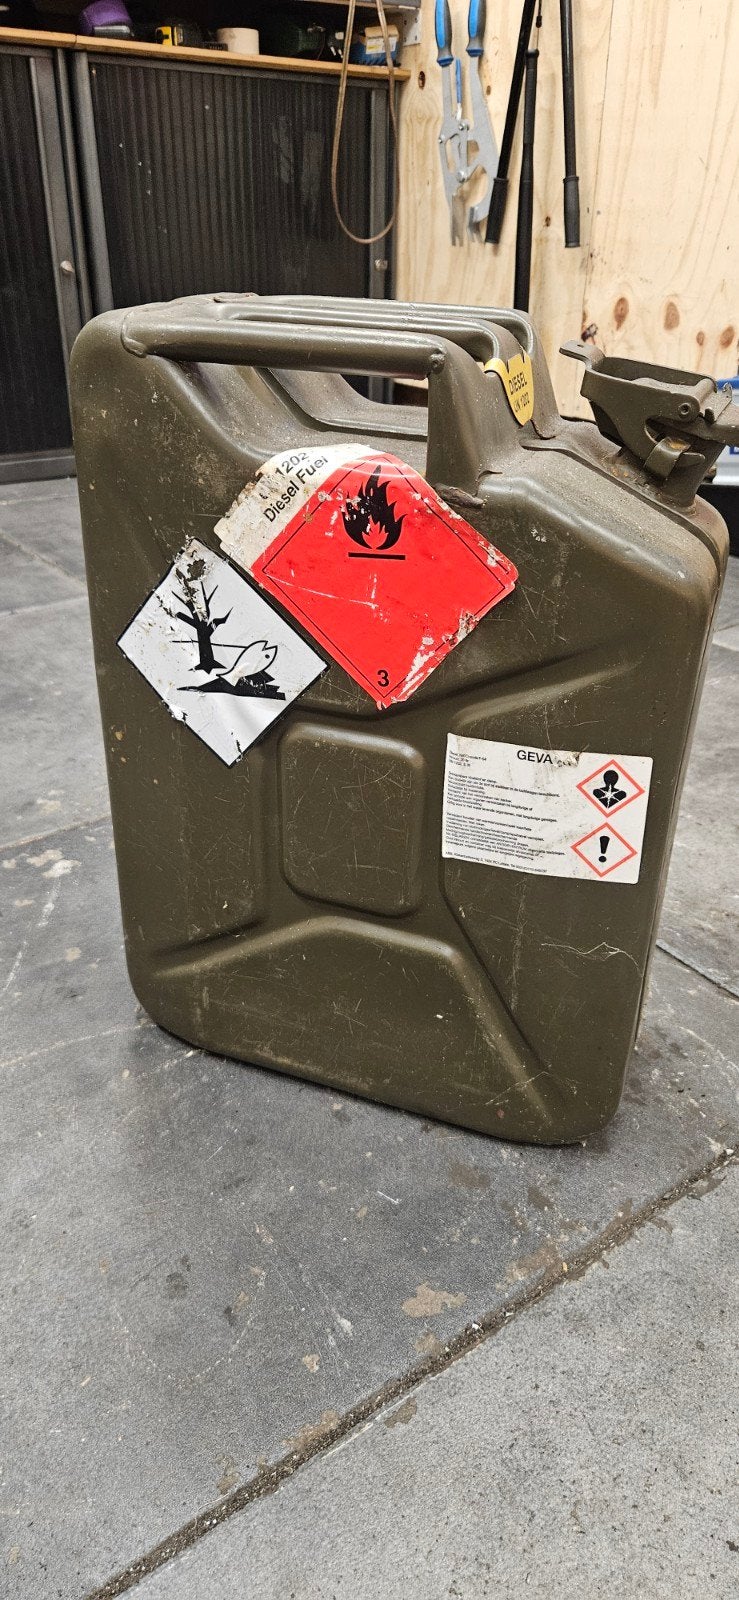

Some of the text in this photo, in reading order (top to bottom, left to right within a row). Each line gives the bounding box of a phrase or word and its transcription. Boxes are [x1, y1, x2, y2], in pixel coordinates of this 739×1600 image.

[508, 372, 528, 395] DIESEL
[275, 452, 309, 477] 1202
[263, 480, 299, 522] Diesel
[296, 455, 328, 484] Fuel
[377, 669, 390, 687] 3
